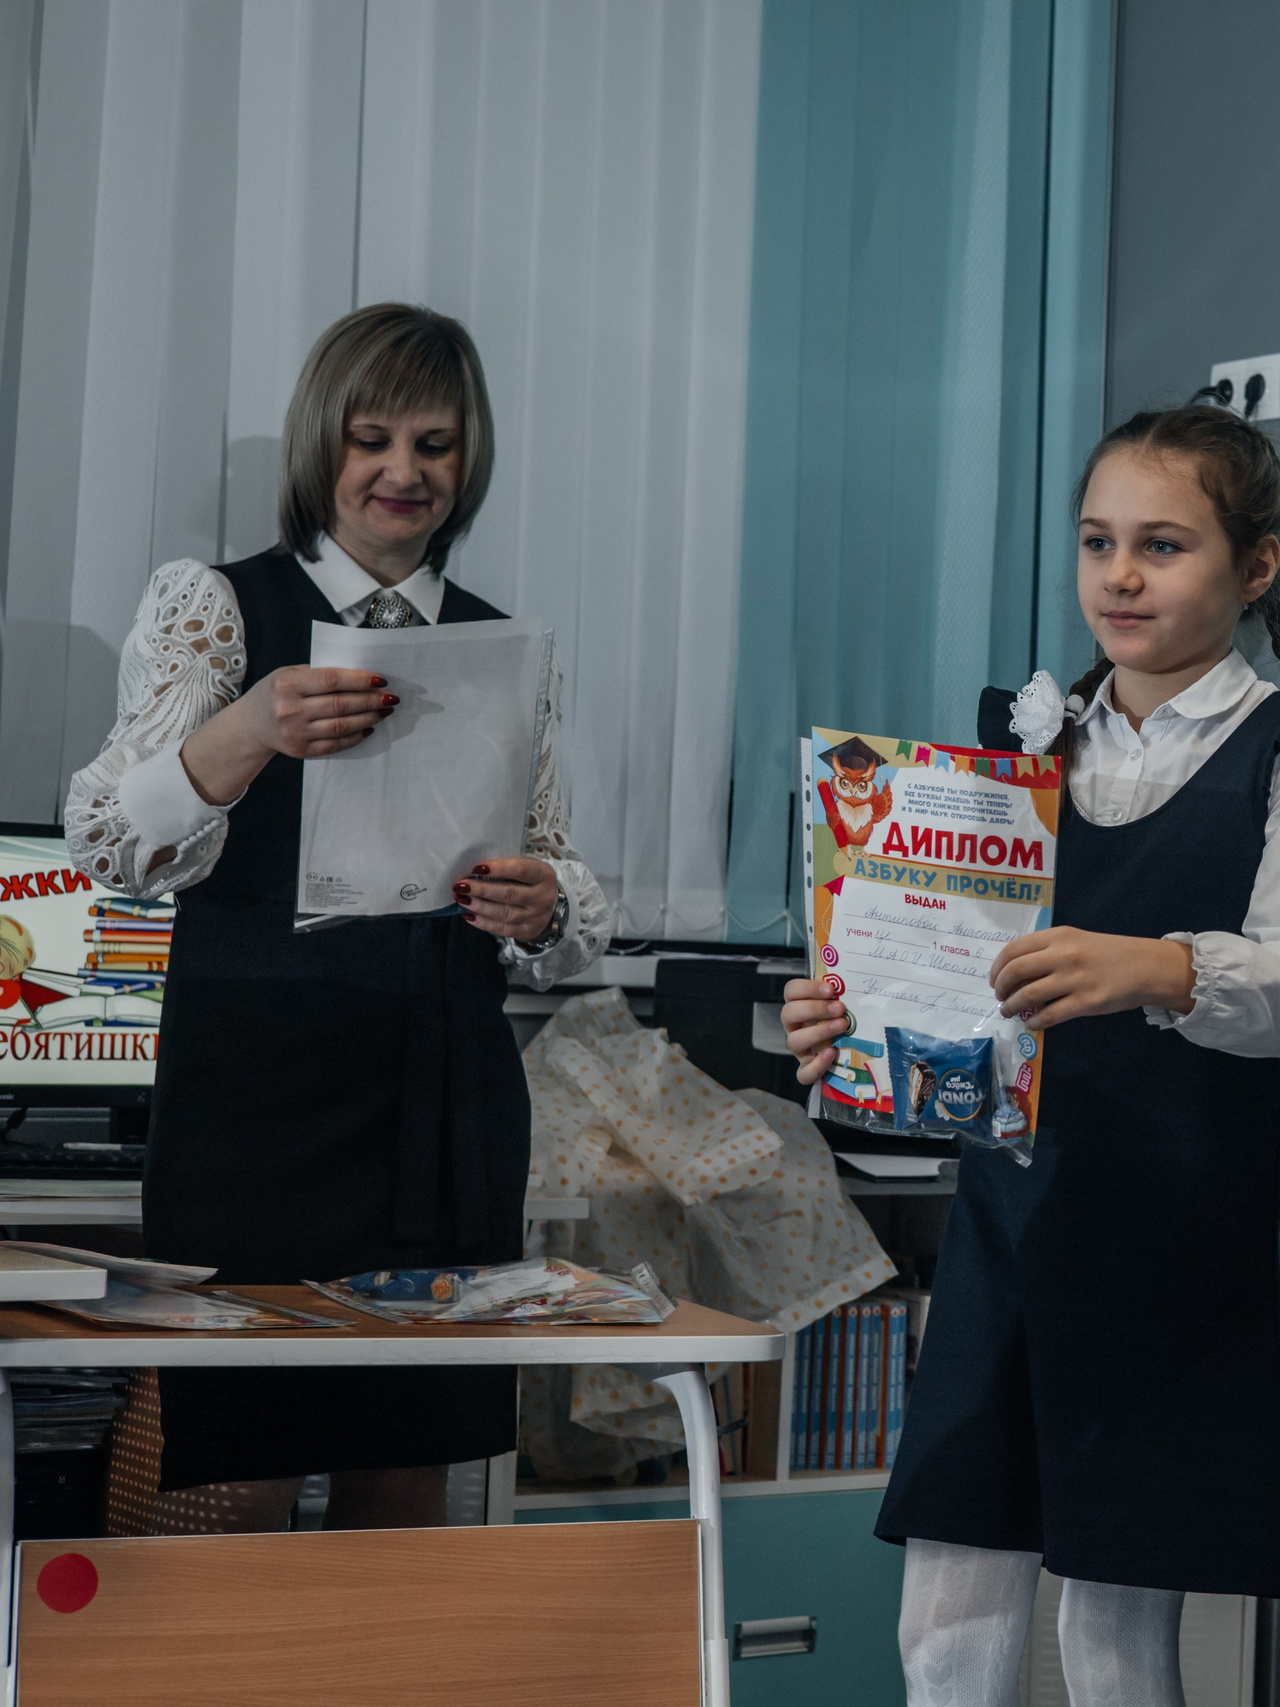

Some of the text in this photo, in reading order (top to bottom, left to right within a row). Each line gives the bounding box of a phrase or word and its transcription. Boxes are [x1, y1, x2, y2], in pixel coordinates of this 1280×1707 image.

[914, 784, 945, 793] АЗБУКОЙ
[917, 792, 942, 801] БУКВЫ
[943, 796, 971, 804] ЗНАЕШЬ
[908, 799, 1008, 816] МНОГО КНИЖЕК ПРОЧИТАЕШЬ
[930, 810, 949, 818] НАУК
[950, 812, 987, 823] ОТКРОЕШЬ
[988, 817, 1015, 826] ДВЕРЬ!
[882, 821, 1044, 872] ДИПЛОМ
[853, 858, 1042, 902] АЗБУКУ ПРОЧЁЛ!
[904, 893, 946, 910] ВЫДАН
[846, 927, 873, 938] учени
[932, 941, 938, 950] 1
[940, 944, 970, 957] класса
